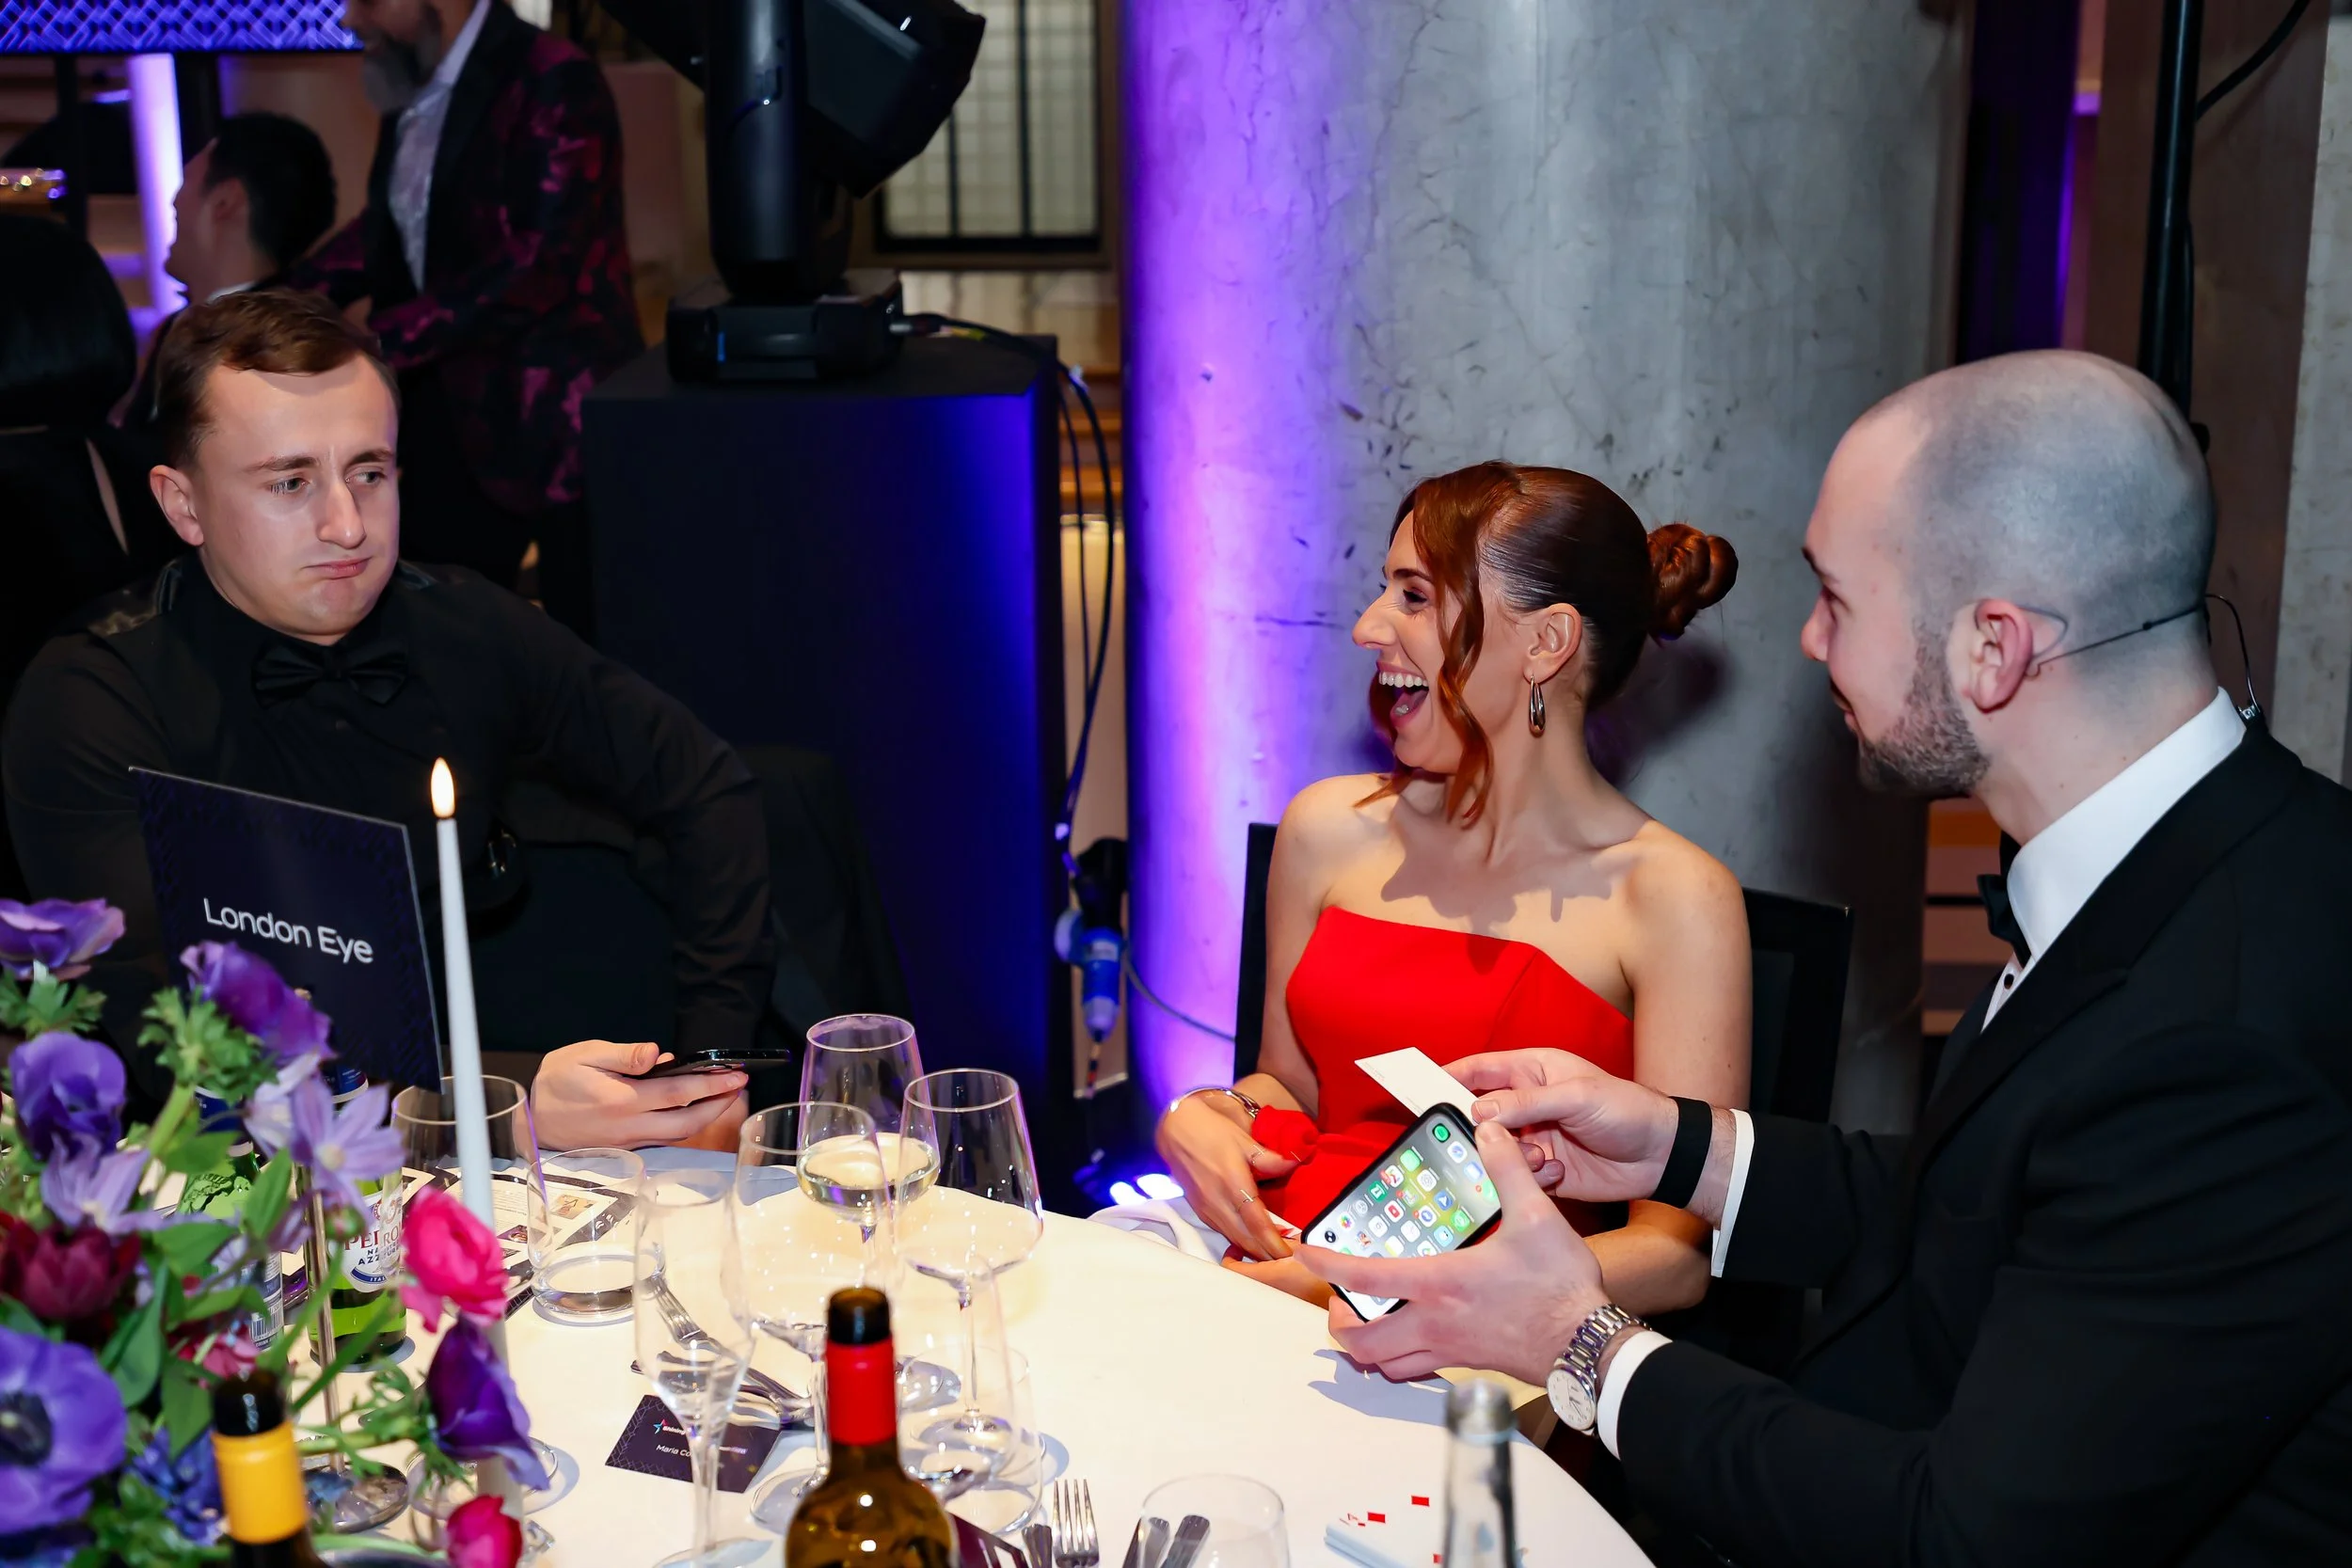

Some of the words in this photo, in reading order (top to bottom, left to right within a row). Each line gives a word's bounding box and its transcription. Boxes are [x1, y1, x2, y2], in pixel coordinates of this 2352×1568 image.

[203, 897, 312, 948] London
[317, 926, 373, 964] Eye
[656, 1444, 679, 1455] Maria
